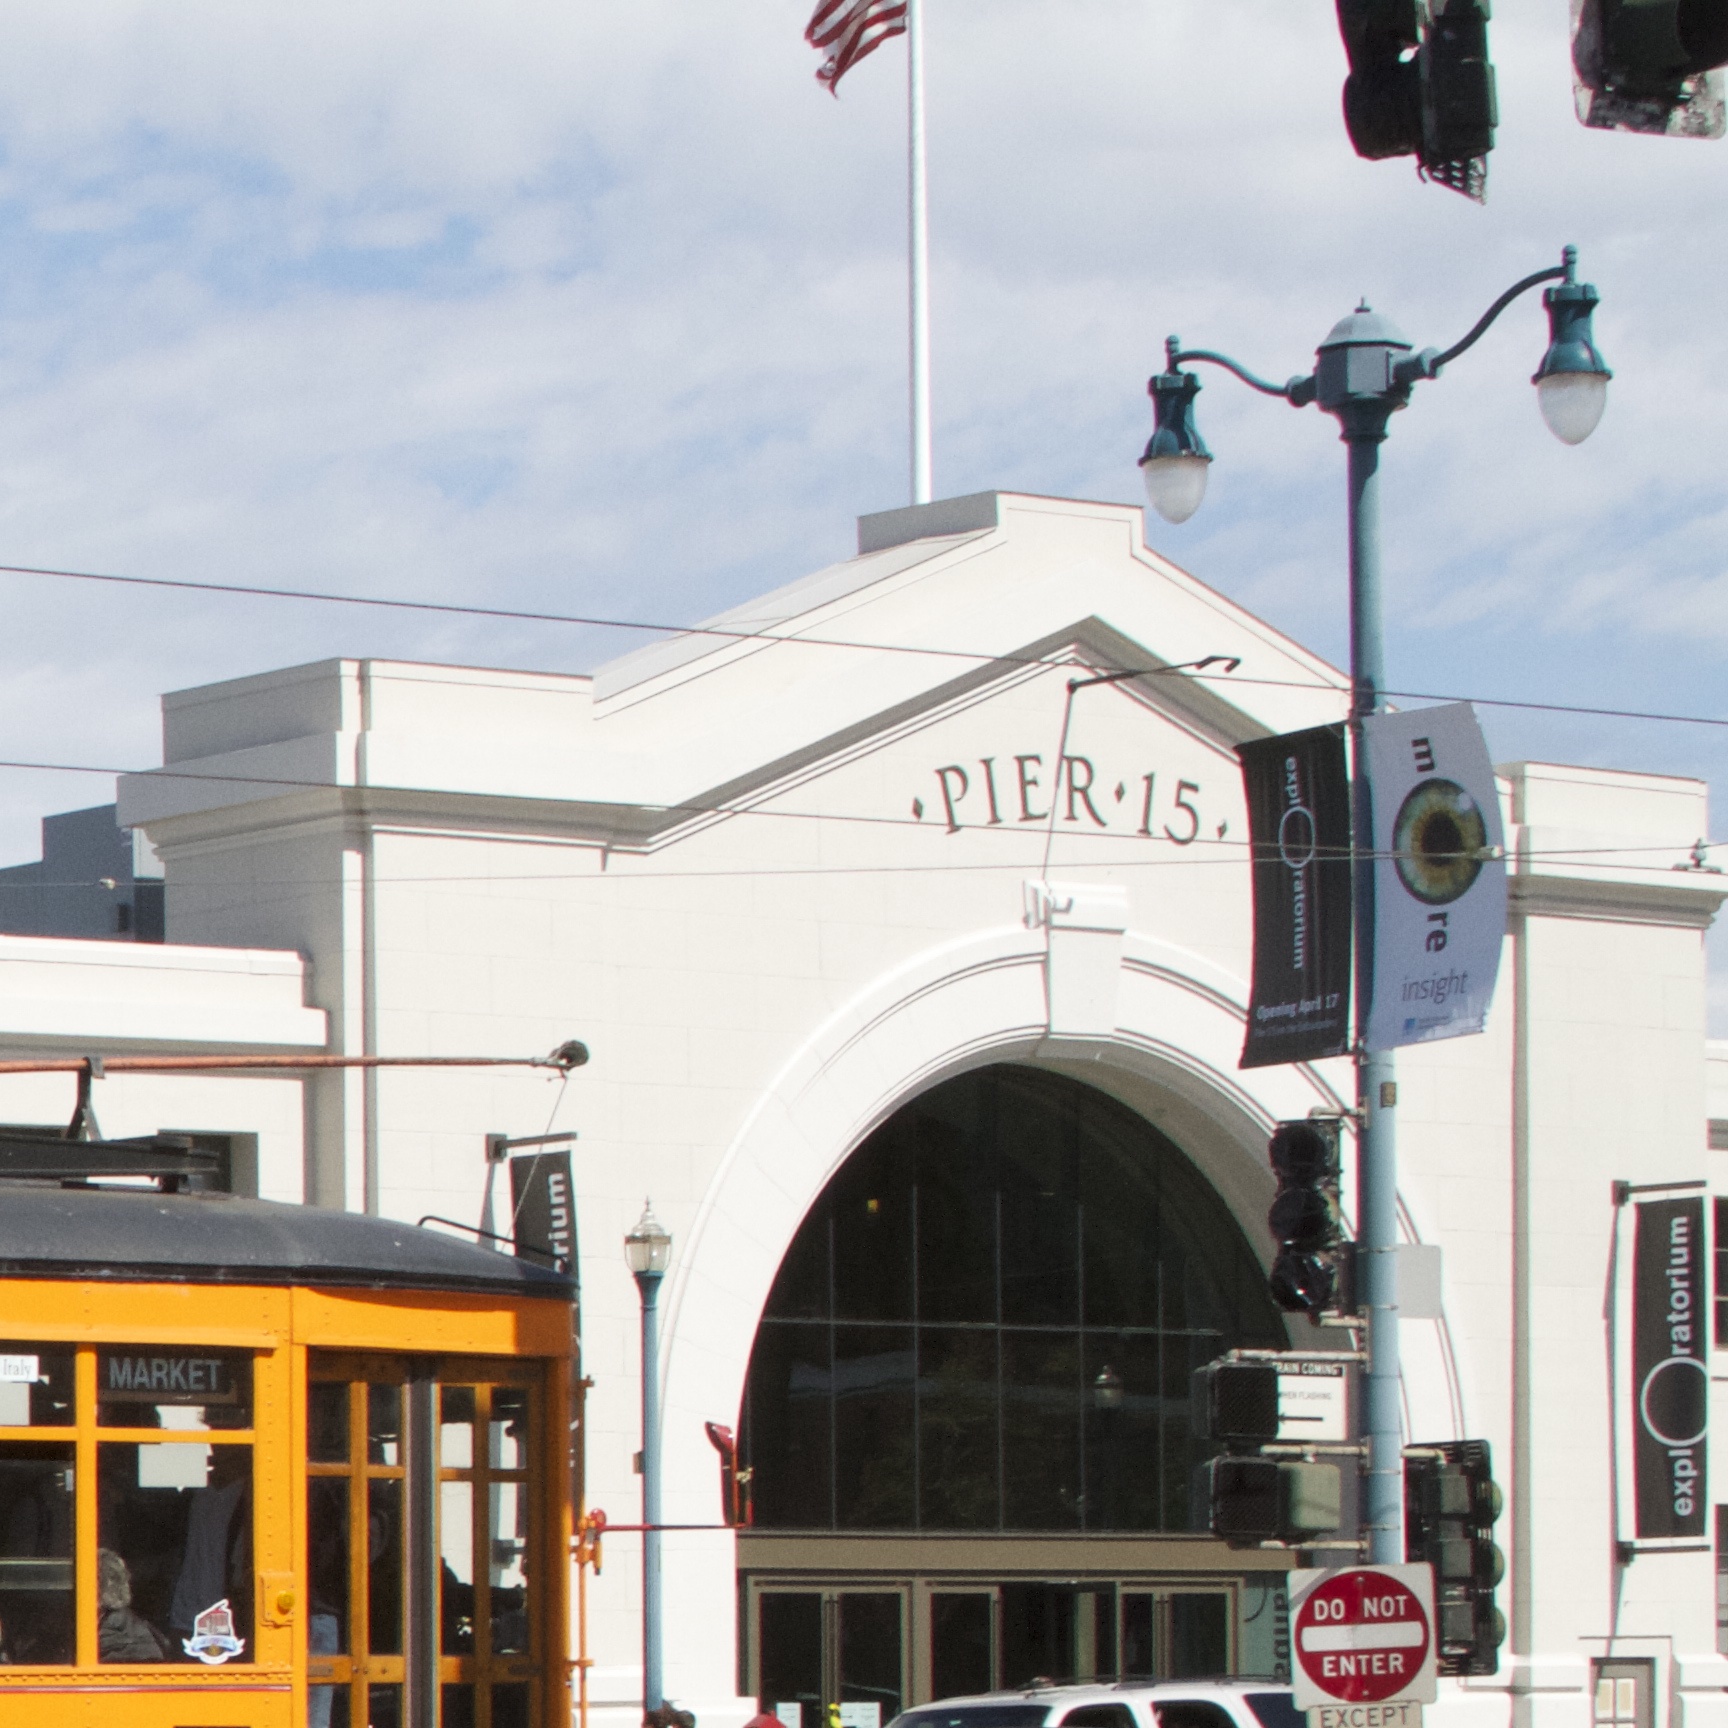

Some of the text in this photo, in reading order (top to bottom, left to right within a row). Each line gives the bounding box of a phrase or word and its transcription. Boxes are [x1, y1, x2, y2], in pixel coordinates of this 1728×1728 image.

[933, 753, 1200, 845] PIER 15
[1401, 968, 1468, 1005] insight
[1256, 1001, 1297, 1021] Opening
[1298, 995, 1322, 1016] April
[3, 1357, 32, 1379] Italy
[108, 1356, 223, 1390] MARKET
[1301, 1362, 1338, 1375] COMING
[1313, 1595, 1408, 1621] DO NOT
[1322, 1653, 1404, 1678] ENTER
